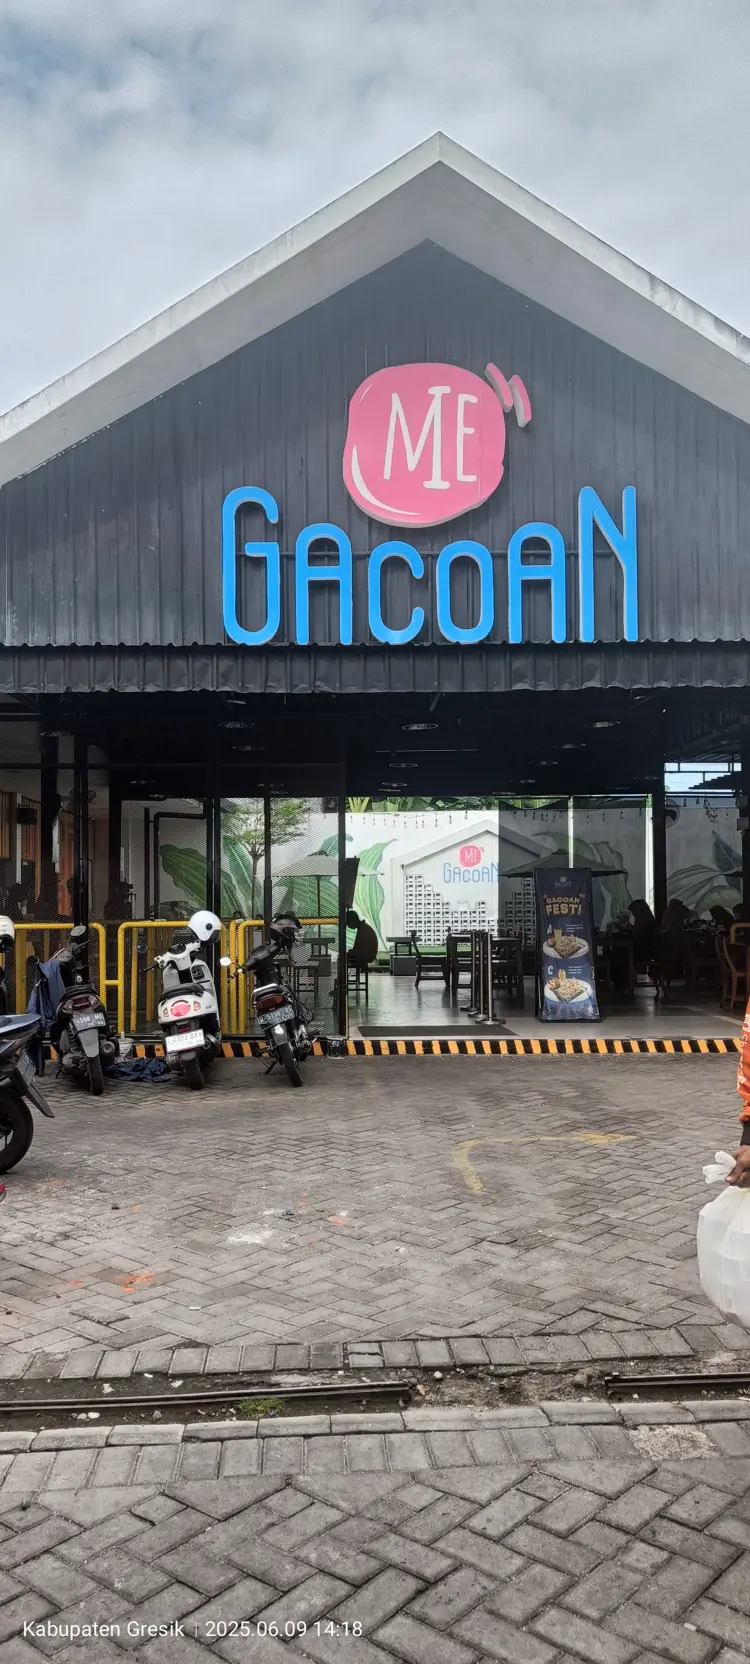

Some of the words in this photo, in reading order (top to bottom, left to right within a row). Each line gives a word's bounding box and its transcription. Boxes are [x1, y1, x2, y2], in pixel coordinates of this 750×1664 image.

[383, 385, 479, 490] ME
[221, 485, 639, 646] GACOAN
[443, 861, 499, 884] GACOAN
[545, 903, 582, 916] FEST!
[547, 965, 554, 975] C
